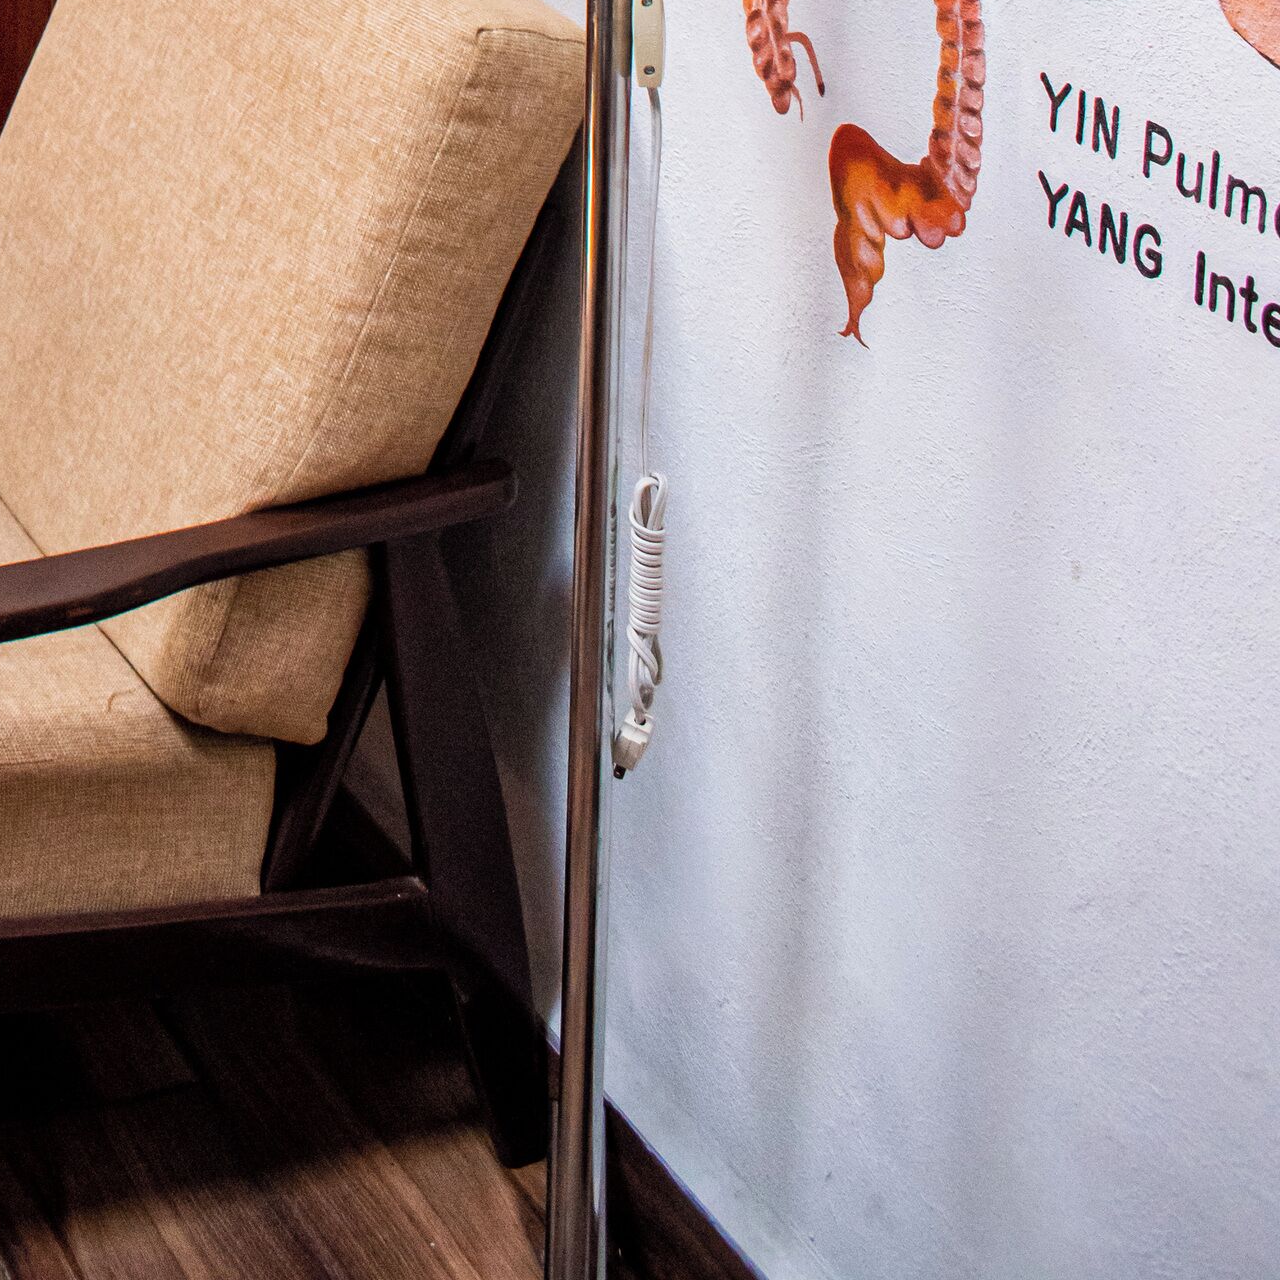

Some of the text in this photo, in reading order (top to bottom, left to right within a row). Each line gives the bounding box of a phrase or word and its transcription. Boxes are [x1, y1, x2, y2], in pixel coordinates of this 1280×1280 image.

[1037, 169, 1163, 279] YANG
[1040, 71, 1280, 240] YIN Pulm
